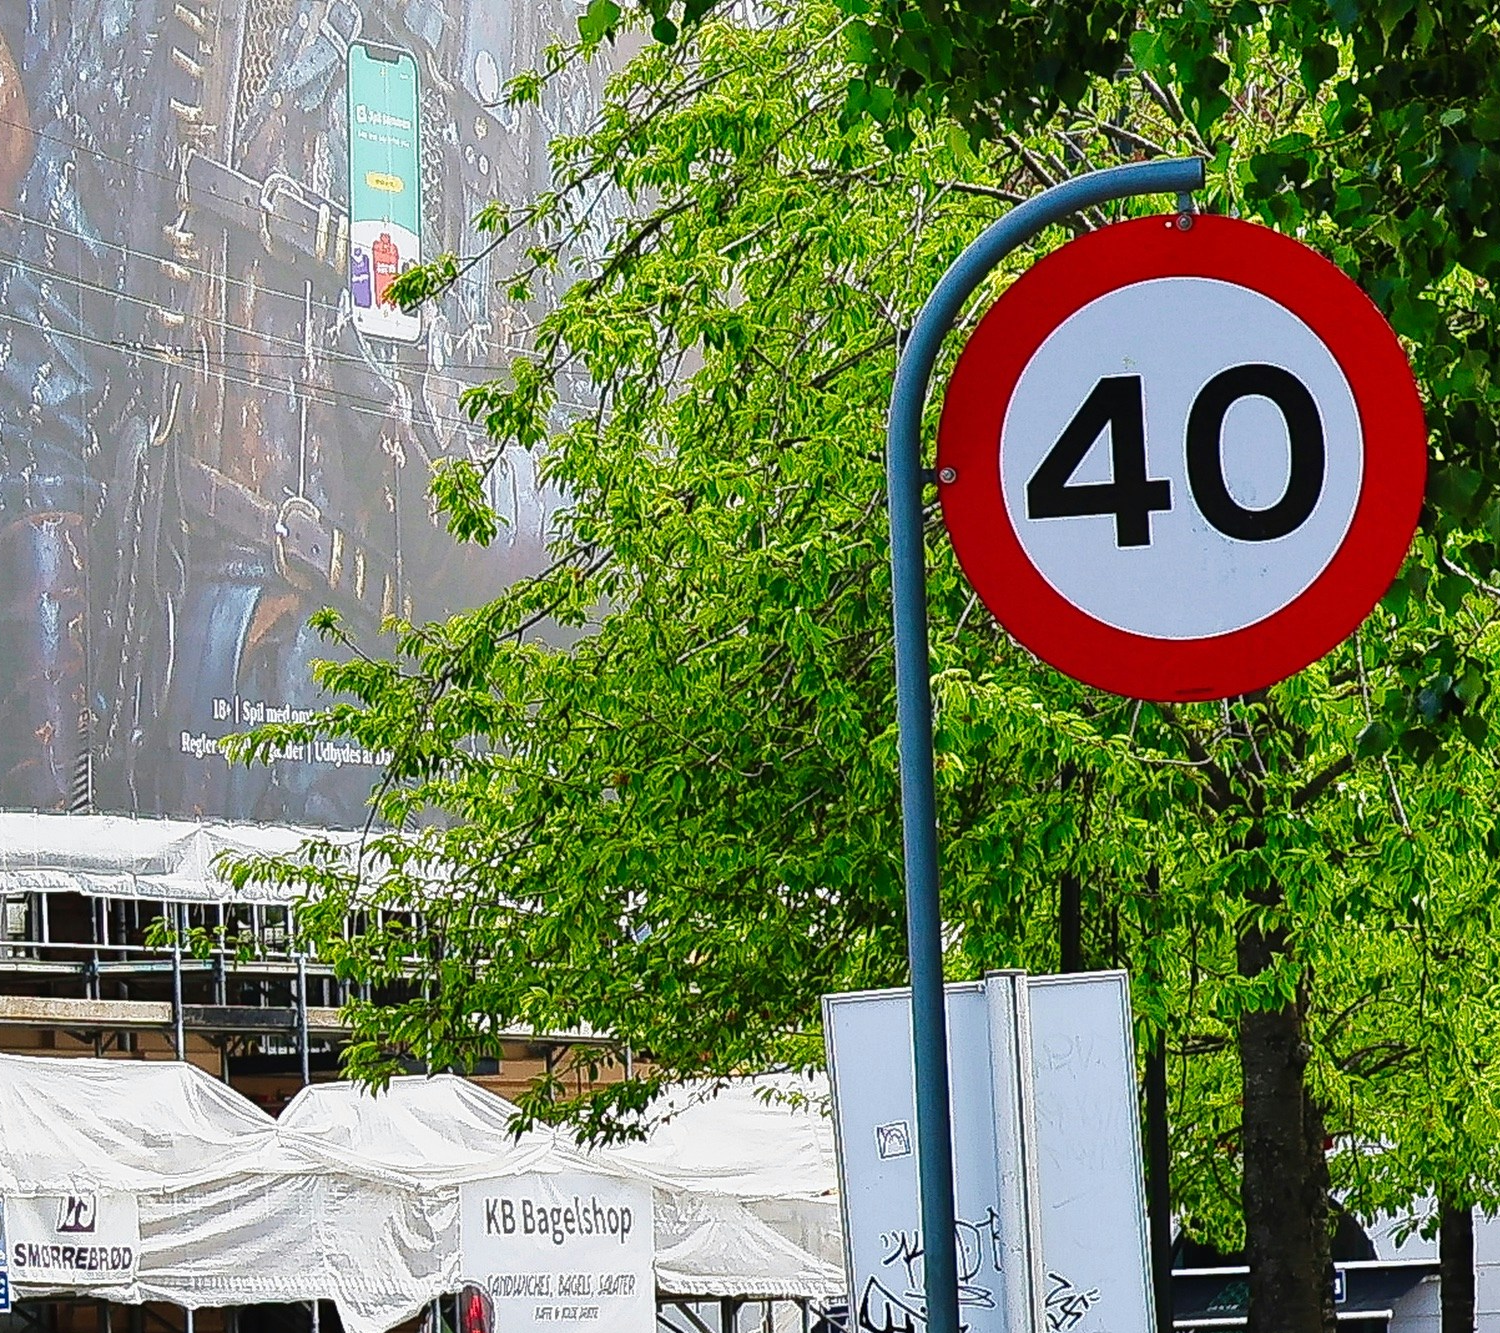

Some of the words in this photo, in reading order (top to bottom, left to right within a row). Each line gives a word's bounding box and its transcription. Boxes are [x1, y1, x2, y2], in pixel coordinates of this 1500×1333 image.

[1025, 362, 1327, 549] 40
[212, 698, 232, 721] 18+
[242, 700, 264, 727] Spil
[314, 740, 361, 768] Udbydes
[485, 1198, 516, 1236] KB
[522, 1196, 633, 1246] Bagelshop
[13, 1242, 133, 1271] SMØRREBRØD
